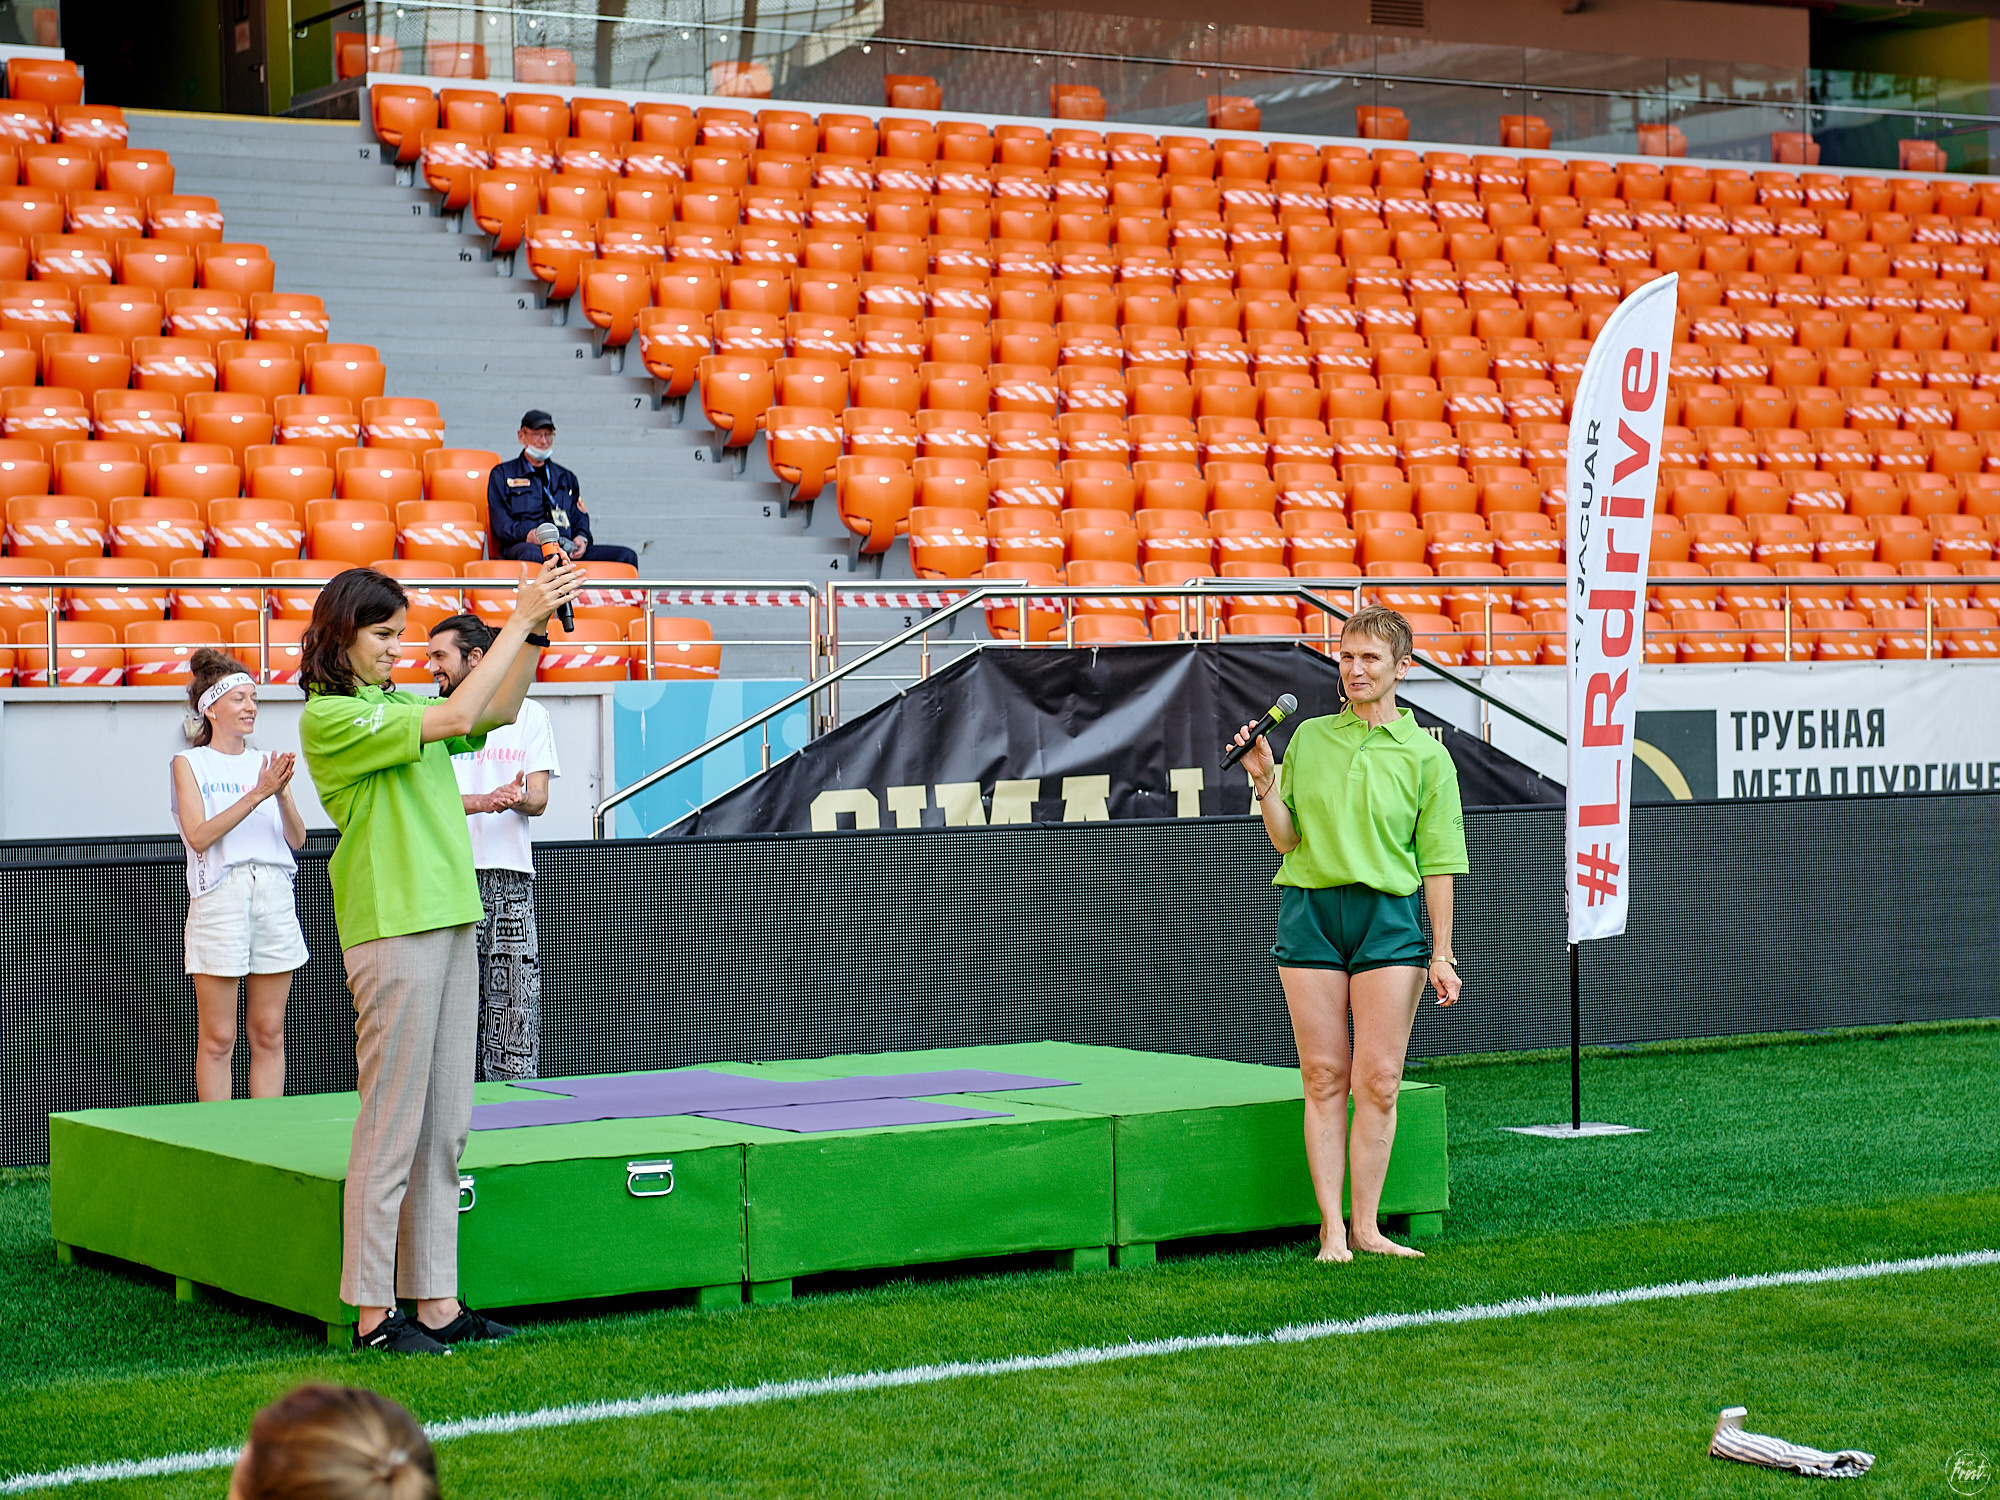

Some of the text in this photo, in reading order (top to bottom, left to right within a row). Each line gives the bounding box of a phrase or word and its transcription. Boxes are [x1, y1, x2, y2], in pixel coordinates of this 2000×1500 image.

[358, 149, 370, 159] 12
[412, 205, 421, 216] 11
[575, 349, 584, 359] 8
[633, 398, 642, 409] 7
[763, 506, 771, 518] 5
[1576, 419, 1602, 597] JAGUAR
[829, 559, 839, 570] 4
[904, 616, 912, 628] 3
[1577, 347, 1659, 907] #LRdrive
[1730, 708, 1885, 751] ТРУБНАЯ
